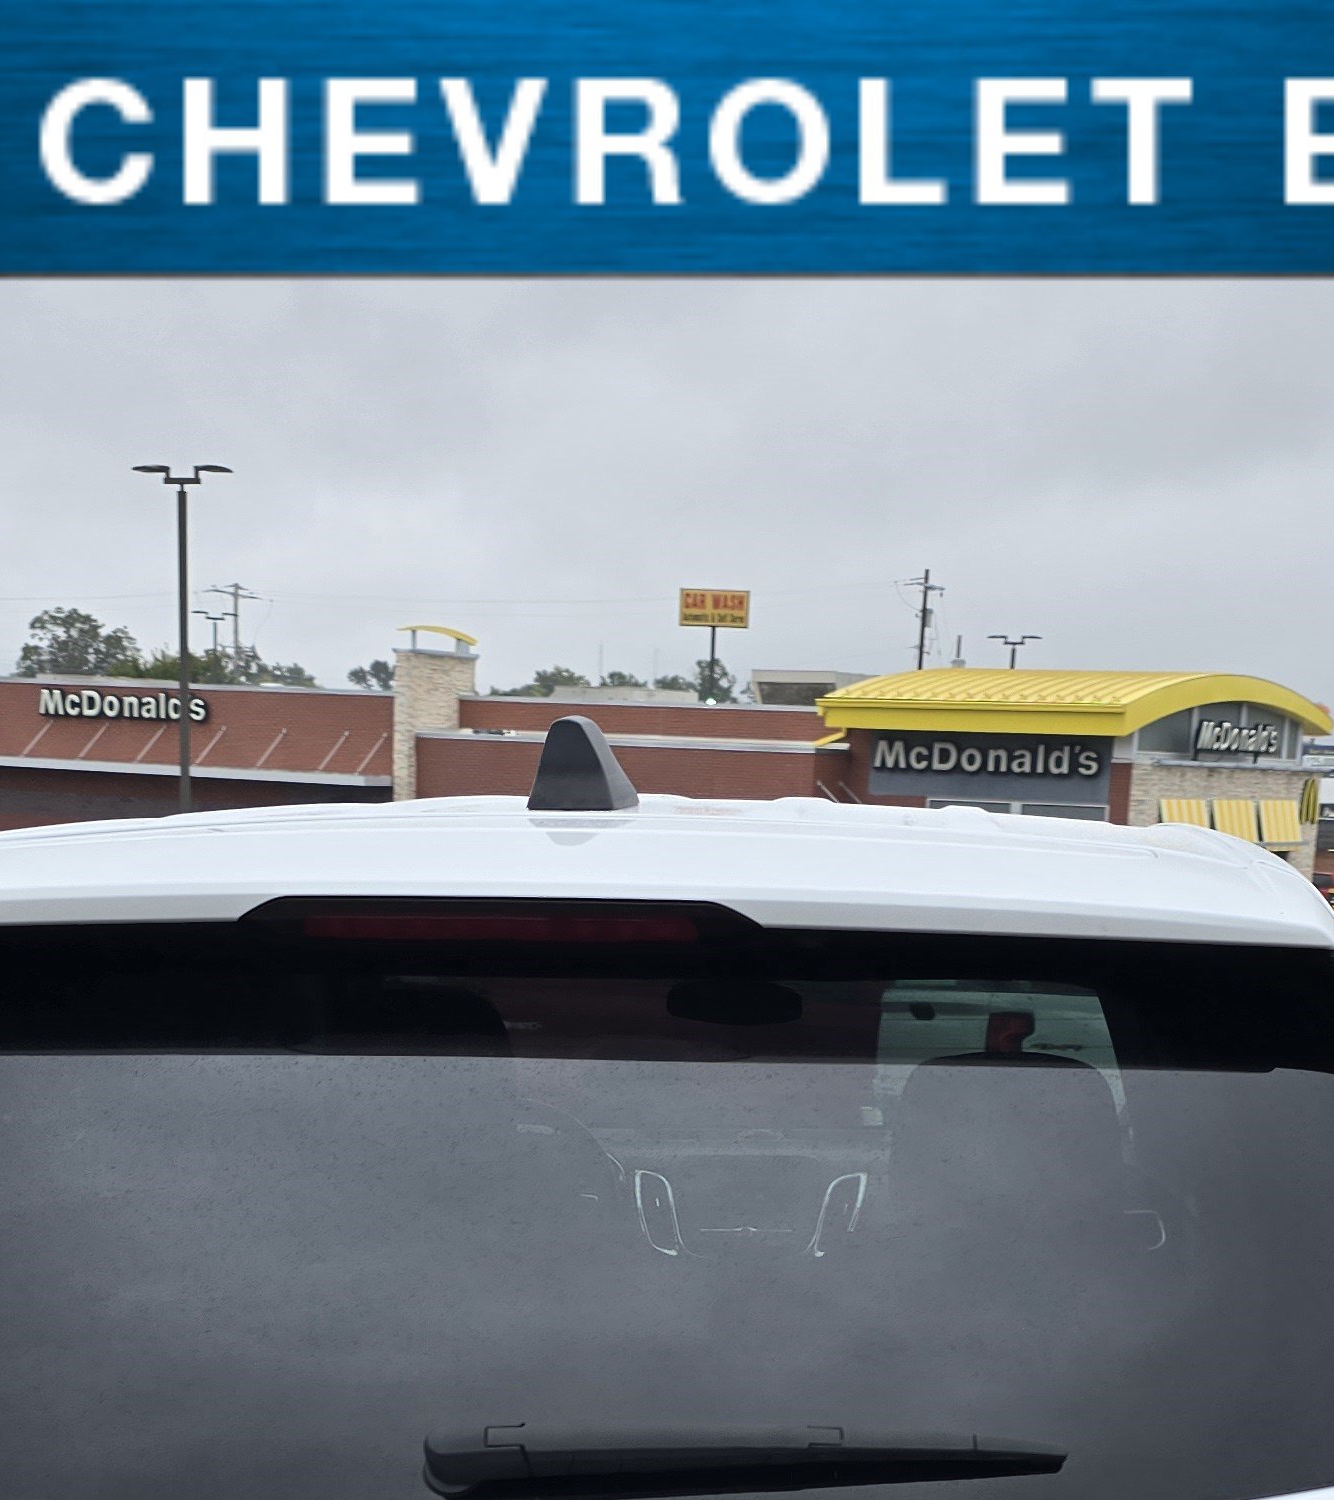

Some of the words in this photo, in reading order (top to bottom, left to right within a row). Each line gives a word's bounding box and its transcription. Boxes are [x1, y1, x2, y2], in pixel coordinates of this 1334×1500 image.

[712, 594, 745, 610] WASH
[38, 688, 207, 722] McDonalds
[1197, 721, 1278, 753] McDonald's
[872, 739, 1100, 776] McDonald's
